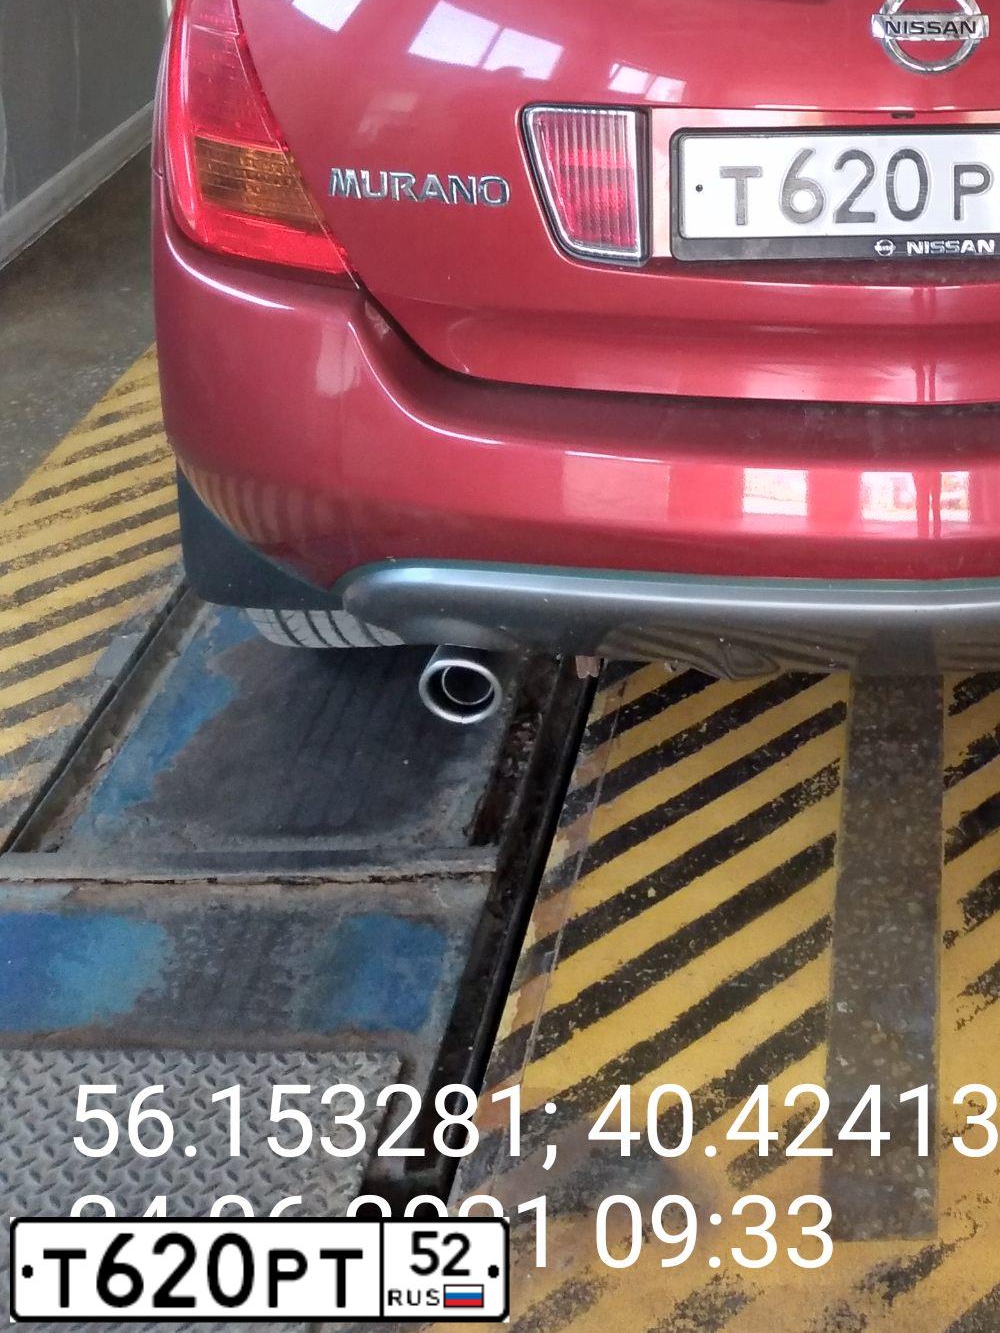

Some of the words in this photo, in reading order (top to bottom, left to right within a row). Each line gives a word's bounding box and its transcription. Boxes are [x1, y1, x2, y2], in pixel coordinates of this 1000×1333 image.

[885, 20, 977, 35] NISSAN
[329, 167, 511, 207] MURANO
[906, 239, 996, 255] NISSAN
